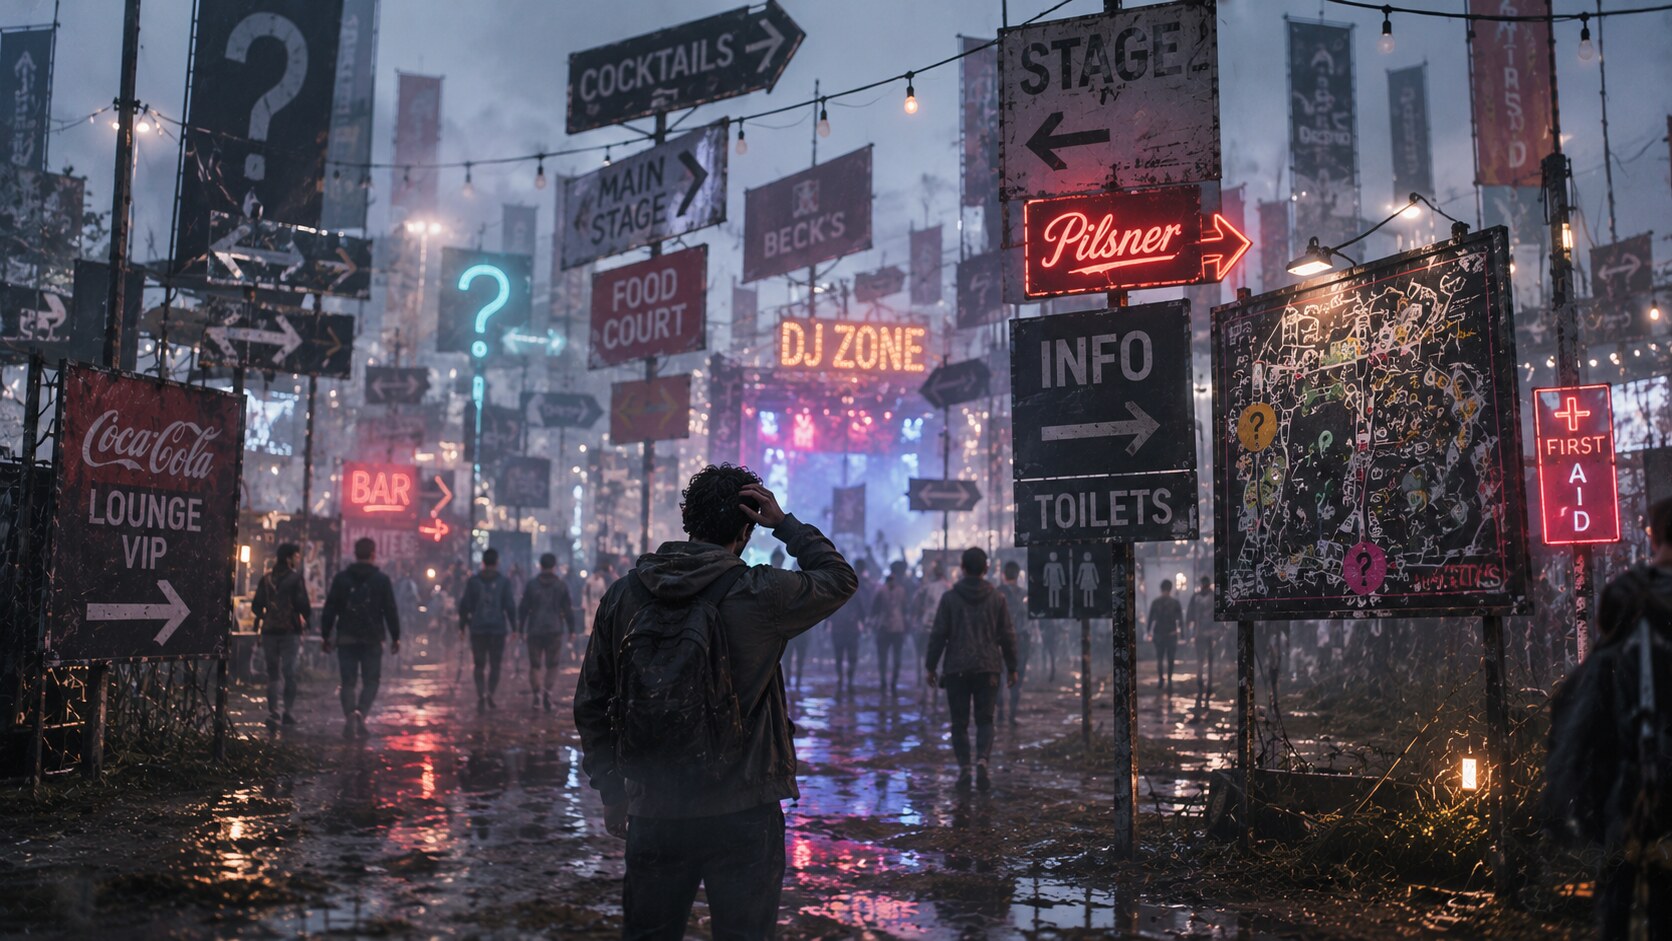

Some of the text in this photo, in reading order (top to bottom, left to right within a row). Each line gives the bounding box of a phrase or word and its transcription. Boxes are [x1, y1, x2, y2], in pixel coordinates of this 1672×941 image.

[579, 32, 735, 102] COCKTAILS
[1019, 22, 1184, 96] STAGE
[596, 154, 666, 209] MAIN
[590, 193, 668, 246] STAGE
[763, 211, 847, 260] BECK'S
[1041, 211, 1183, 269] Pilsner
[611, 267, 679, 314] FOOD
[602, 303, 689, 351] COURT
[780, 320, 926, 373] DJ ZONE
[1040, 329, 1154, 389] INFO
[82, 409, 224, 480] Coca-Cola
[1546, 435, 1606, 456] FIRST
[88, 487, 203, 534] LOUNGE
[351, 470, 412, 506] BAR
[1034, 487, 1174, 531] TOILETS
[1568, 462, 1591, 533] AID
[121, 534, 168, 571] VIP
